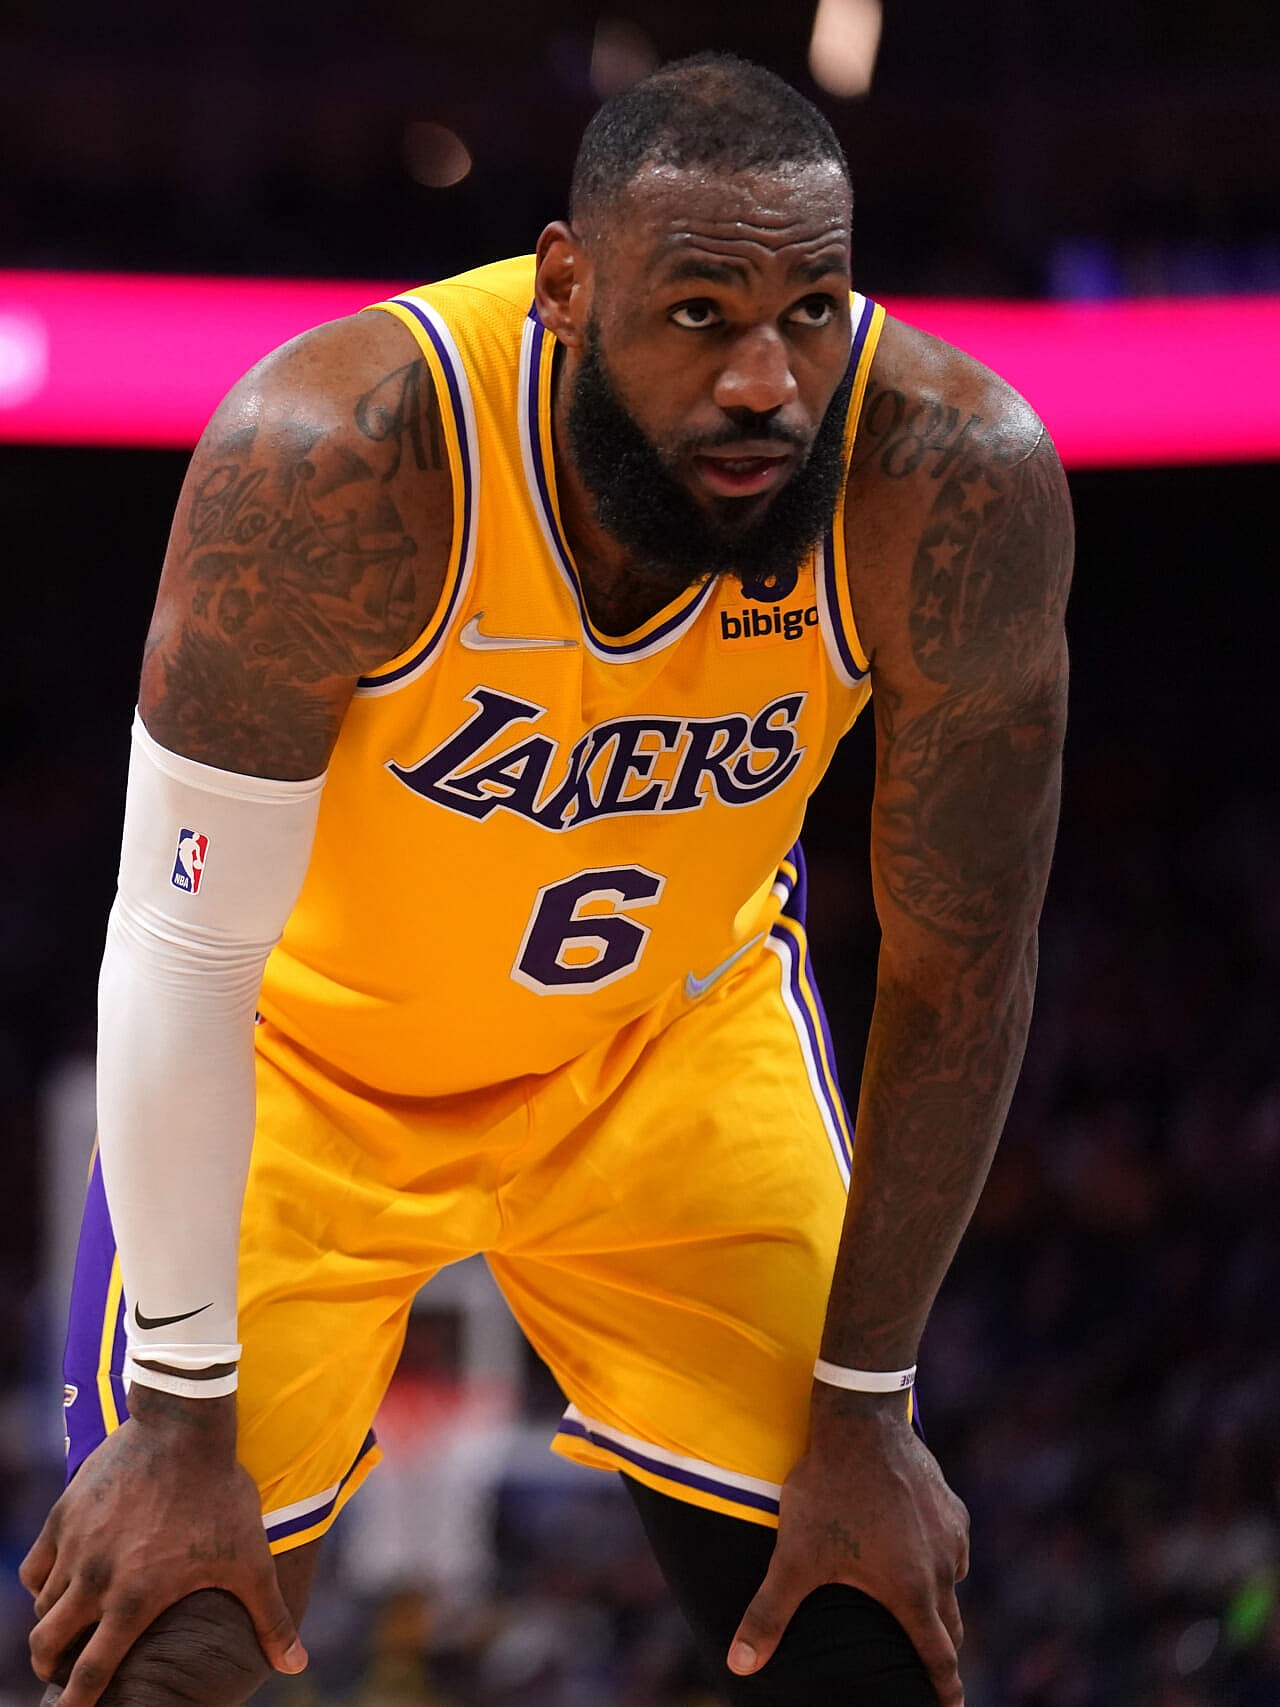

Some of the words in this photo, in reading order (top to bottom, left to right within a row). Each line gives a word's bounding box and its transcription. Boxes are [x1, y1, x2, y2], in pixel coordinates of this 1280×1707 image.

[720, 605, 819, 641] bibigo
[384, 684, 809, 833] LAKERS
[174, 873, 189, 888] NBA
[510, 863, 667, 996] 6
